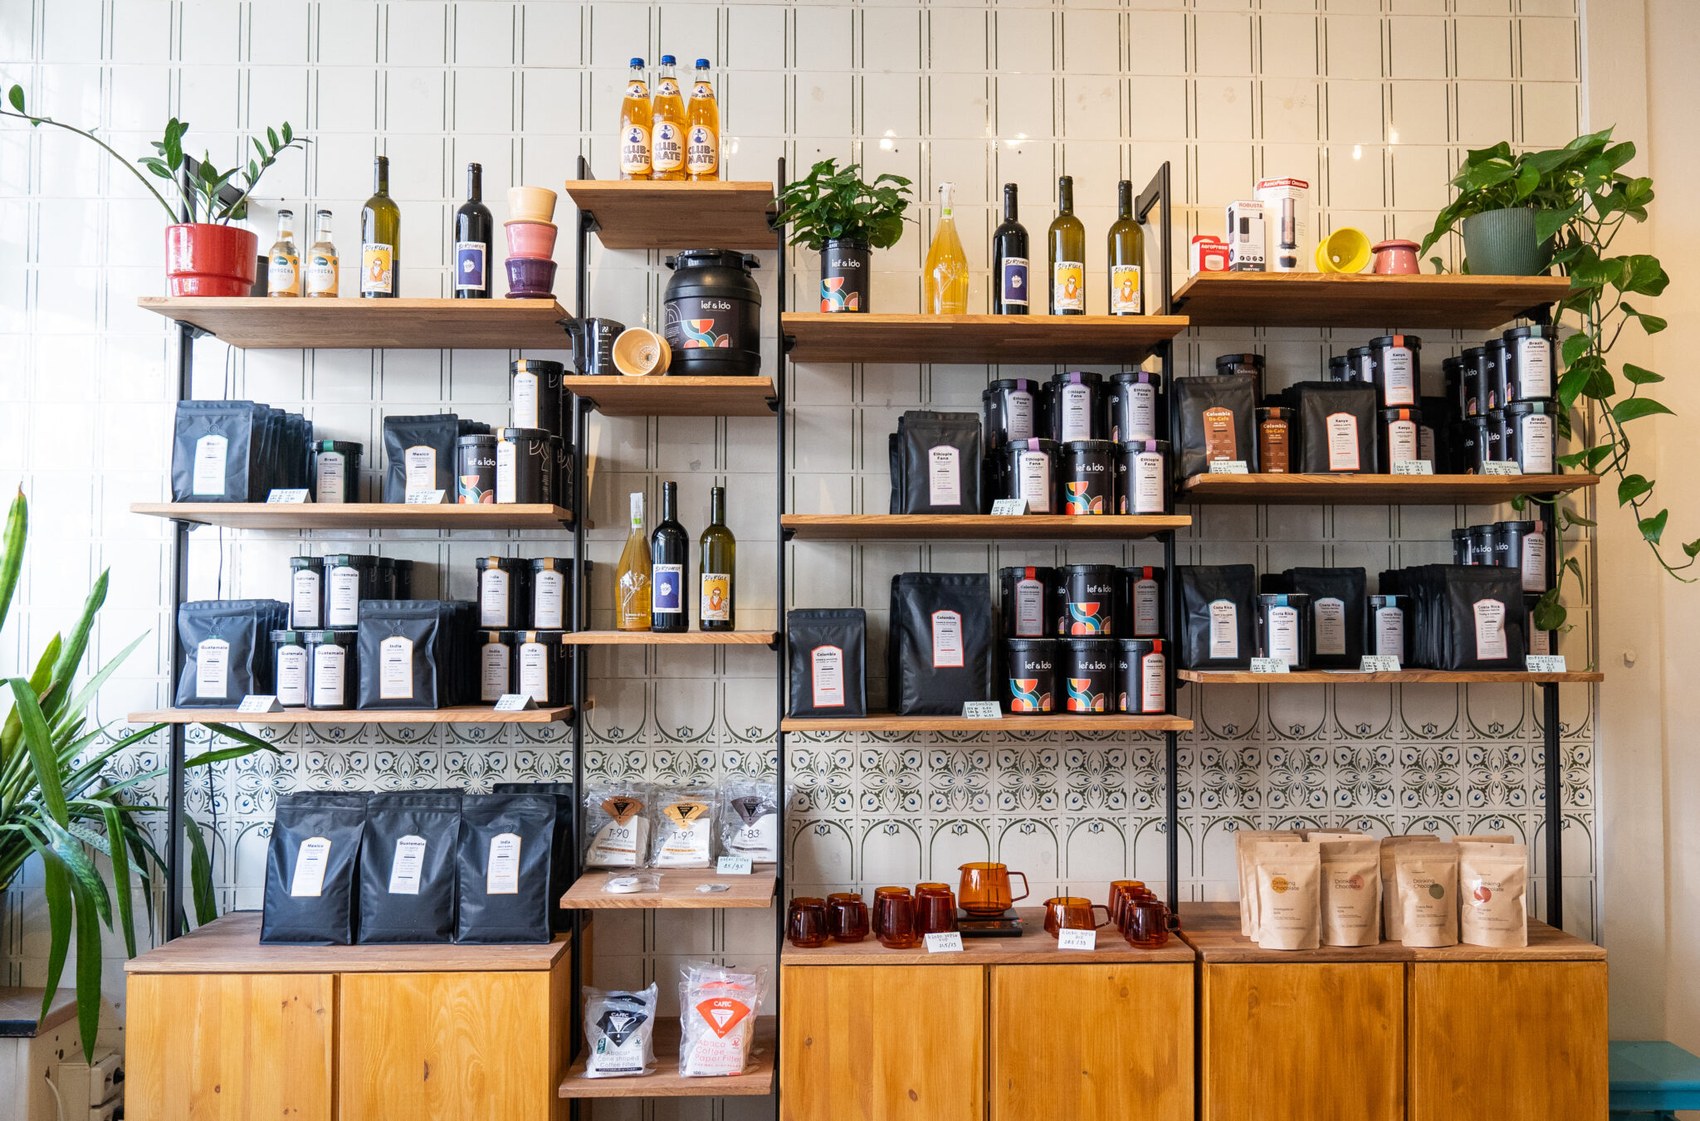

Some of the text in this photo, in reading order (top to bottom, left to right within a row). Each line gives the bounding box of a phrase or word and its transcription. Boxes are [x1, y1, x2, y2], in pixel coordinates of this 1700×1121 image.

[1092, 462, 1105, 472] ido
[1102, 583, 1112, 593] ido
[1024, 660, 1035, 670] ief
[1041, 660, 1052, 670] ido
[1078, 660, 1089, 670] ief
[1095, 660, 1106, 670] ido
[609, 828, 629, 839] T-90
[740, 829, 760, 839] T-83
